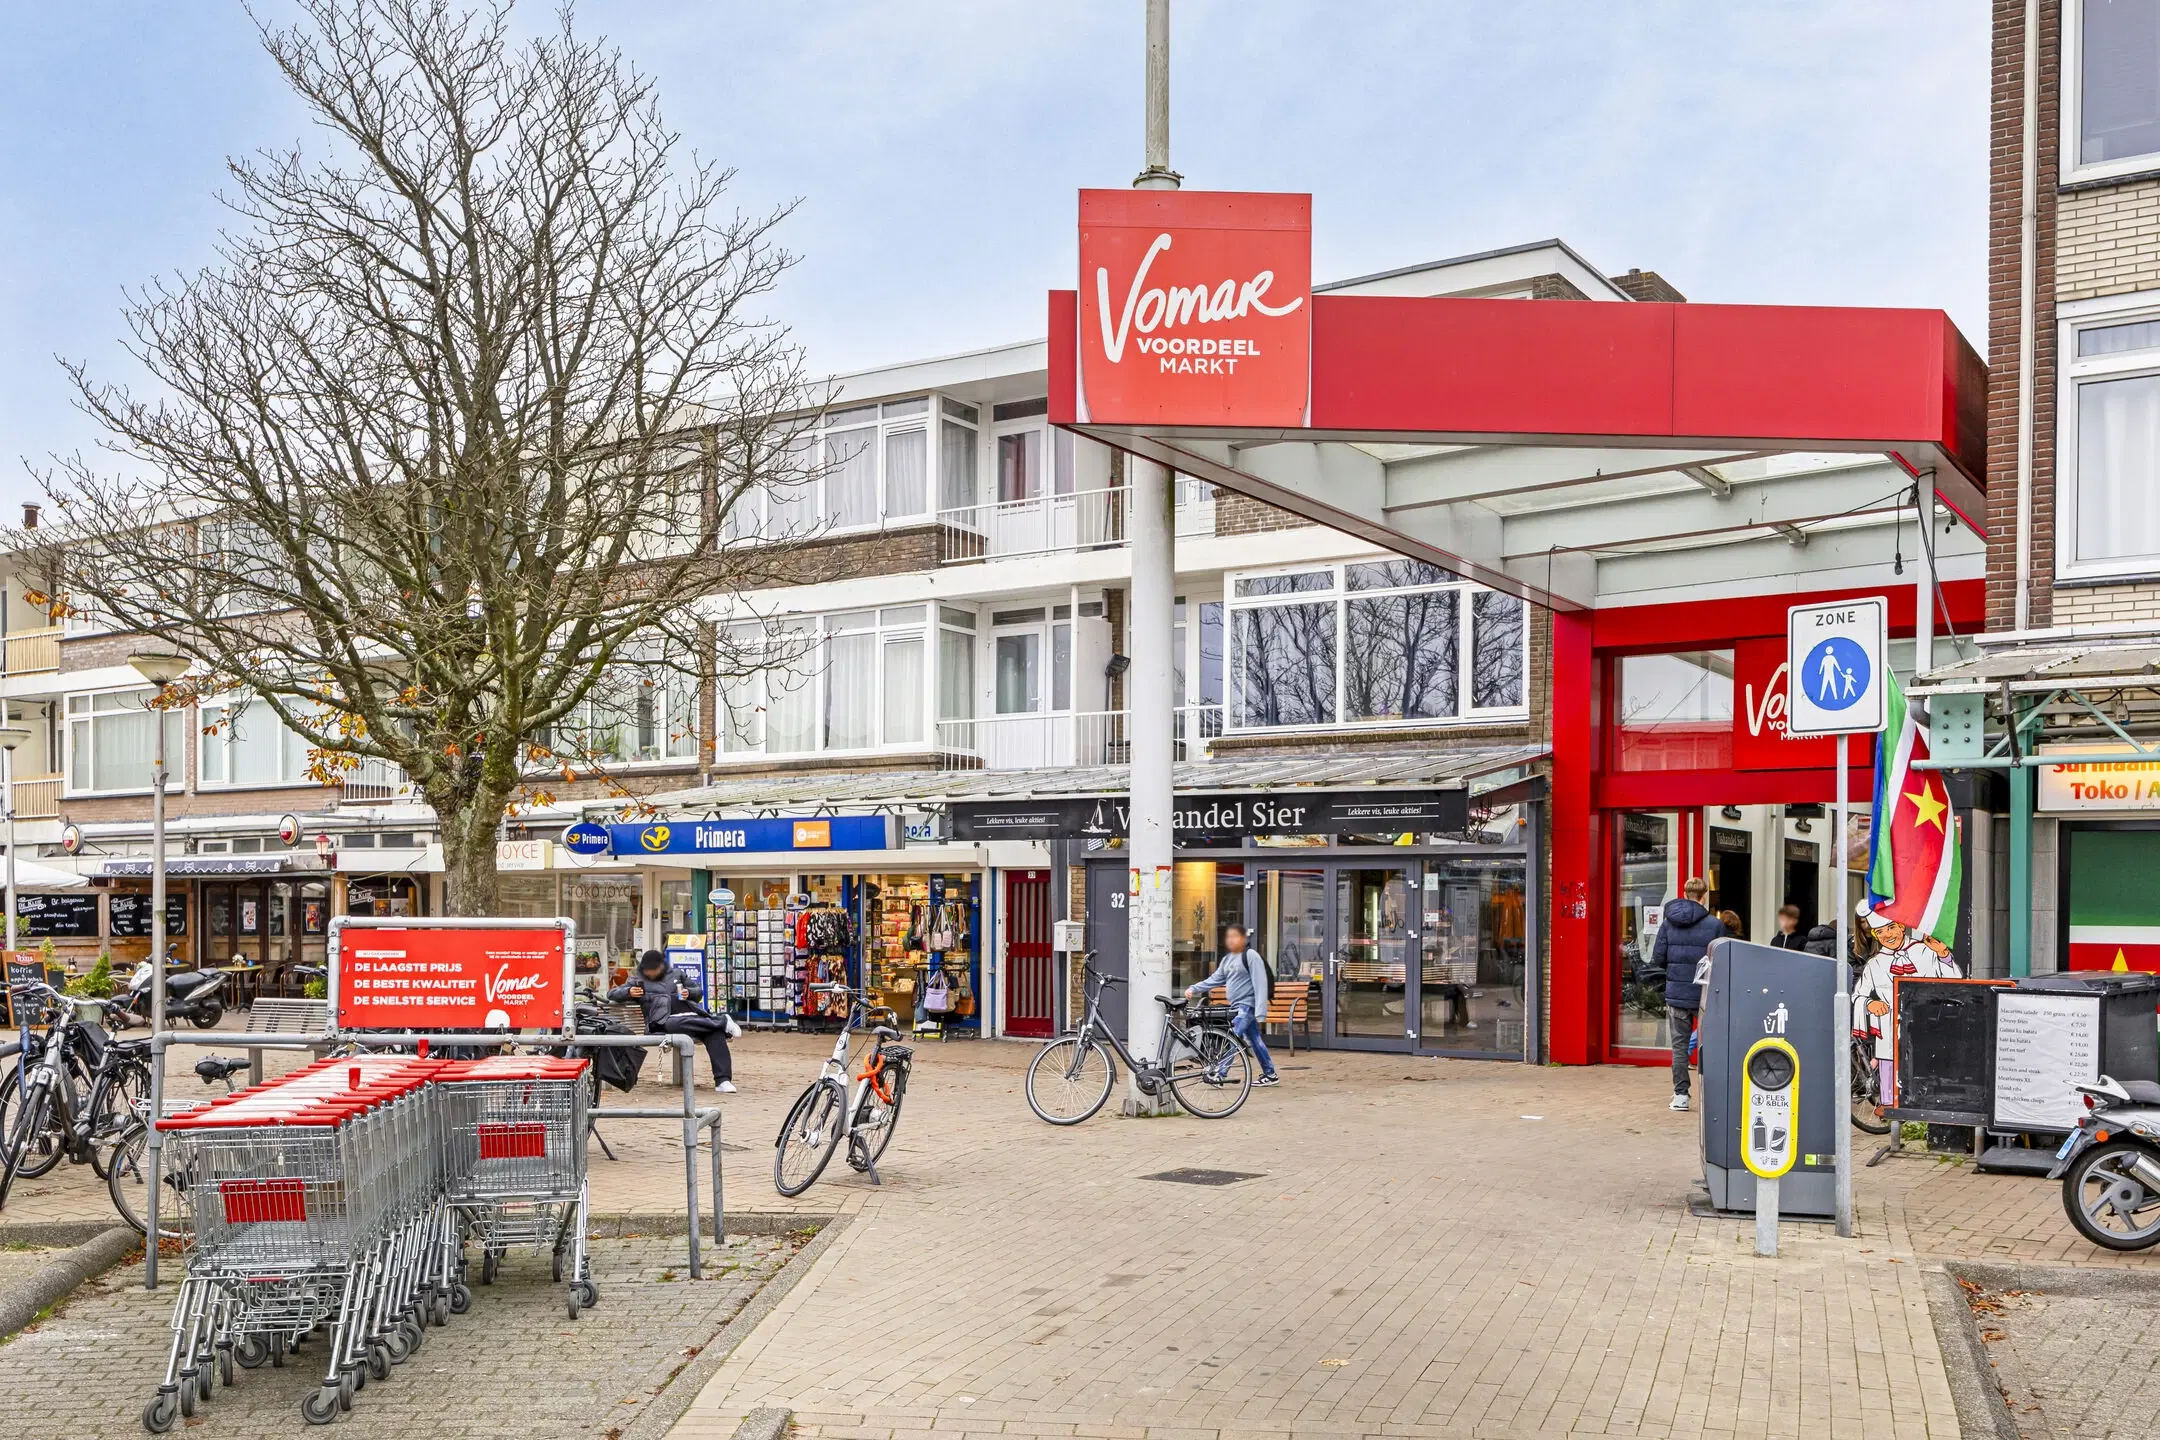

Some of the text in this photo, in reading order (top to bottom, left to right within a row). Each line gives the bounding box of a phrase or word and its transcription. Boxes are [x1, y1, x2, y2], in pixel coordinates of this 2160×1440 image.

[1097, 233, 1303, 363] Vomar
[1137, 338, 1260, 356] VOORDEEL
[1160, 358, 1238, 375] MARKT
[1816, 611, 1856, 626] ZONE
[2070, 780, 2128, 800] Toko
[1252, 801, 1306, 828] Sier
[1383, 807, 1400, 815] leuke
[1400, 806, 1422, 814] akties!
[582, 833, 608, 844] Primera
[695, 826, 746, 848] Primera
[496, 843, 538, 859] JOYCE
[568, 886, 637, 898] TOKO JOYCE
[1111, 893, 1125, 908] 32
[354, 962, 462, 972] DE LAAGSTE PRIJS
[354, 979, 476, 989] DE BESTE KWALITEIT
[485, 963, 549, 1002] Vomar
[353, 996, 476, 1006] DE SNELSTE SERVICE
